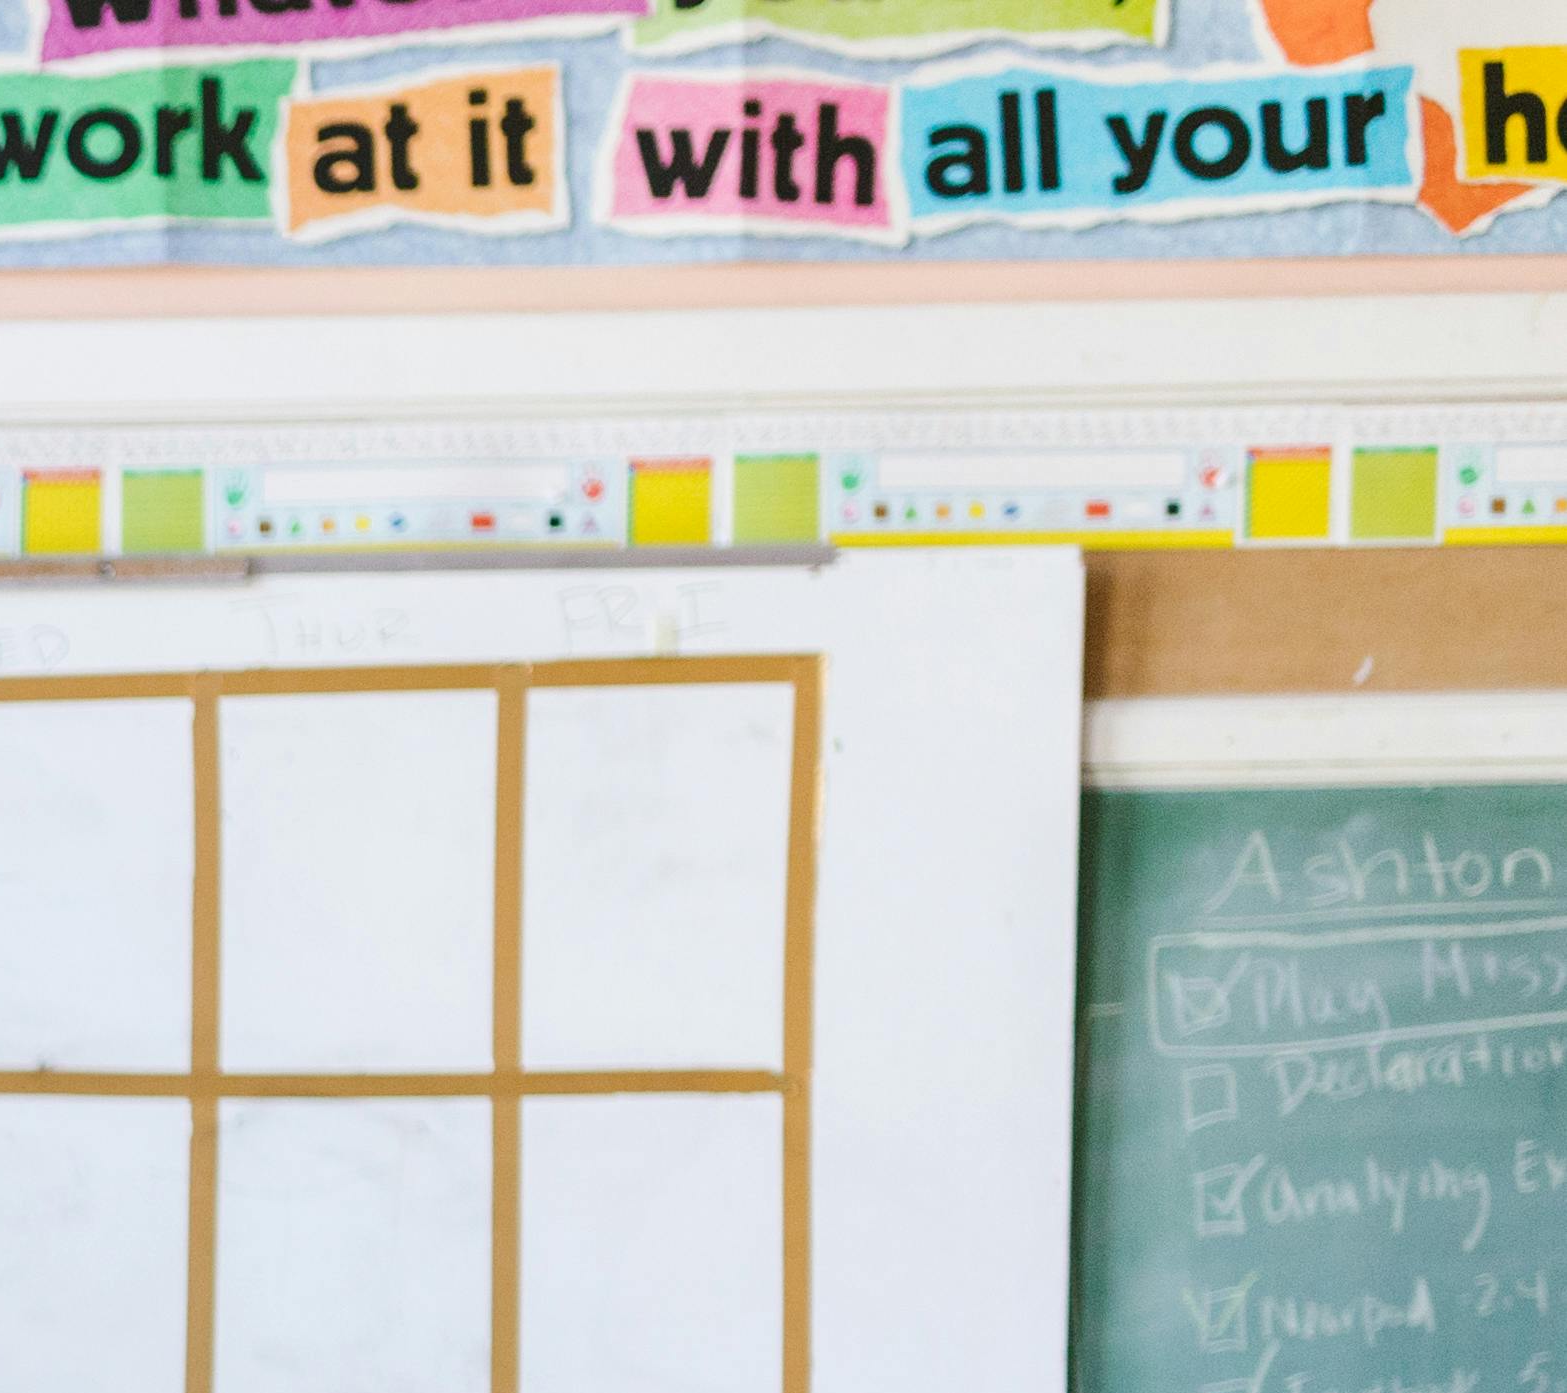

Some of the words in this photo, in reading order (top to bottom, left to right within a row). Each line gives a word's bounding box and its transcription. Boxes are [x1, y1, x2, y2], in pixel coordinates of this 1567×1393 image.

[313, 93, 419, 194] at
[468, 89, 536, 187] it
[636, 98, 877, 207] with
[926, 90, 1061, 197] all
[1106, 84, 1387, 192] your
[1483, 61, 1567, 165] h
[1201, 828, 1556, 915] Ashton
